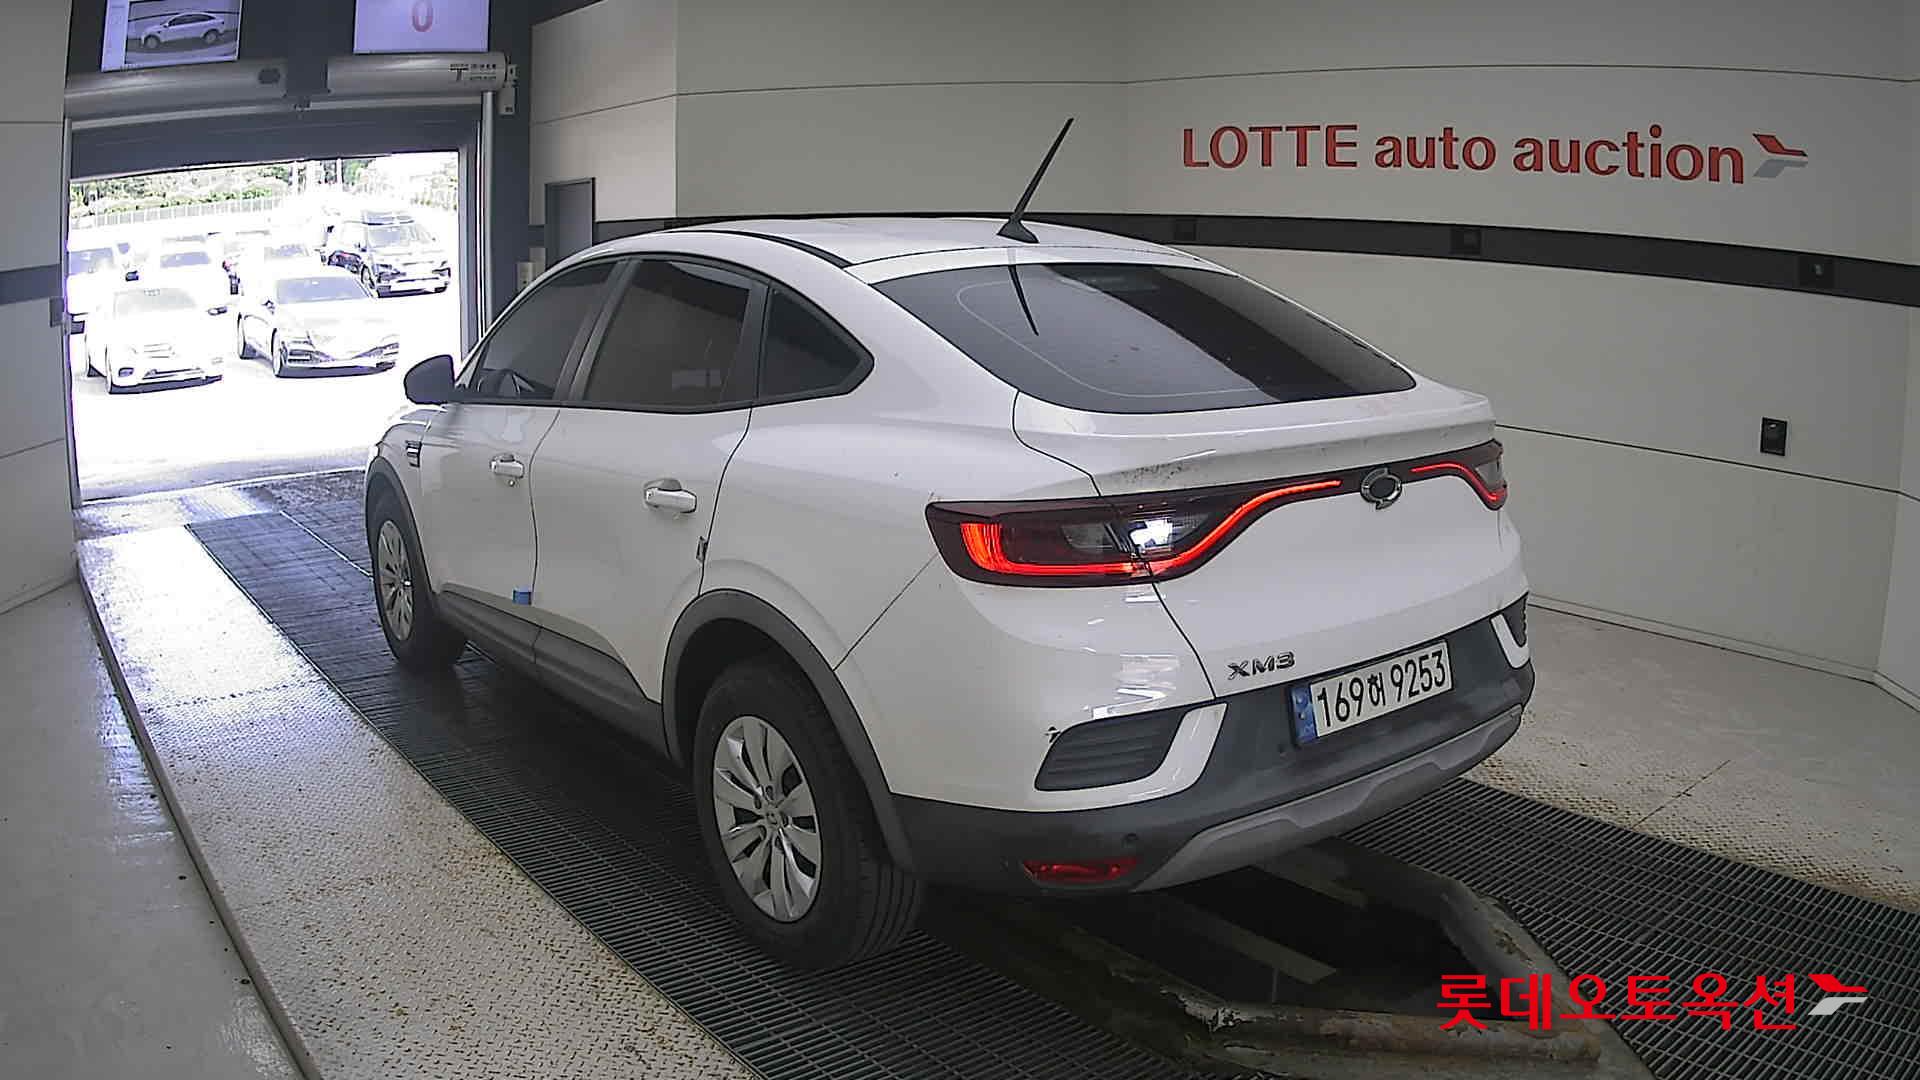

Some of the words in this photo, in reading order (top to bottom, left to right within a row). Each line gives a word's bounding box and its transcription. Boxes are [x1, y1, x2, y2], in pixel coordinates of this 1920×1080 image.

[1183, 125, 1358, 168] LOTTE
[1374, 127, 1497, 171] auto
[1513, 124, 1744, 184] auction
[1227, 651, 1295, 680] XM3
[1317, 672, 1386, 728] 169허
[1390, 649, 1446, 703] 9253
